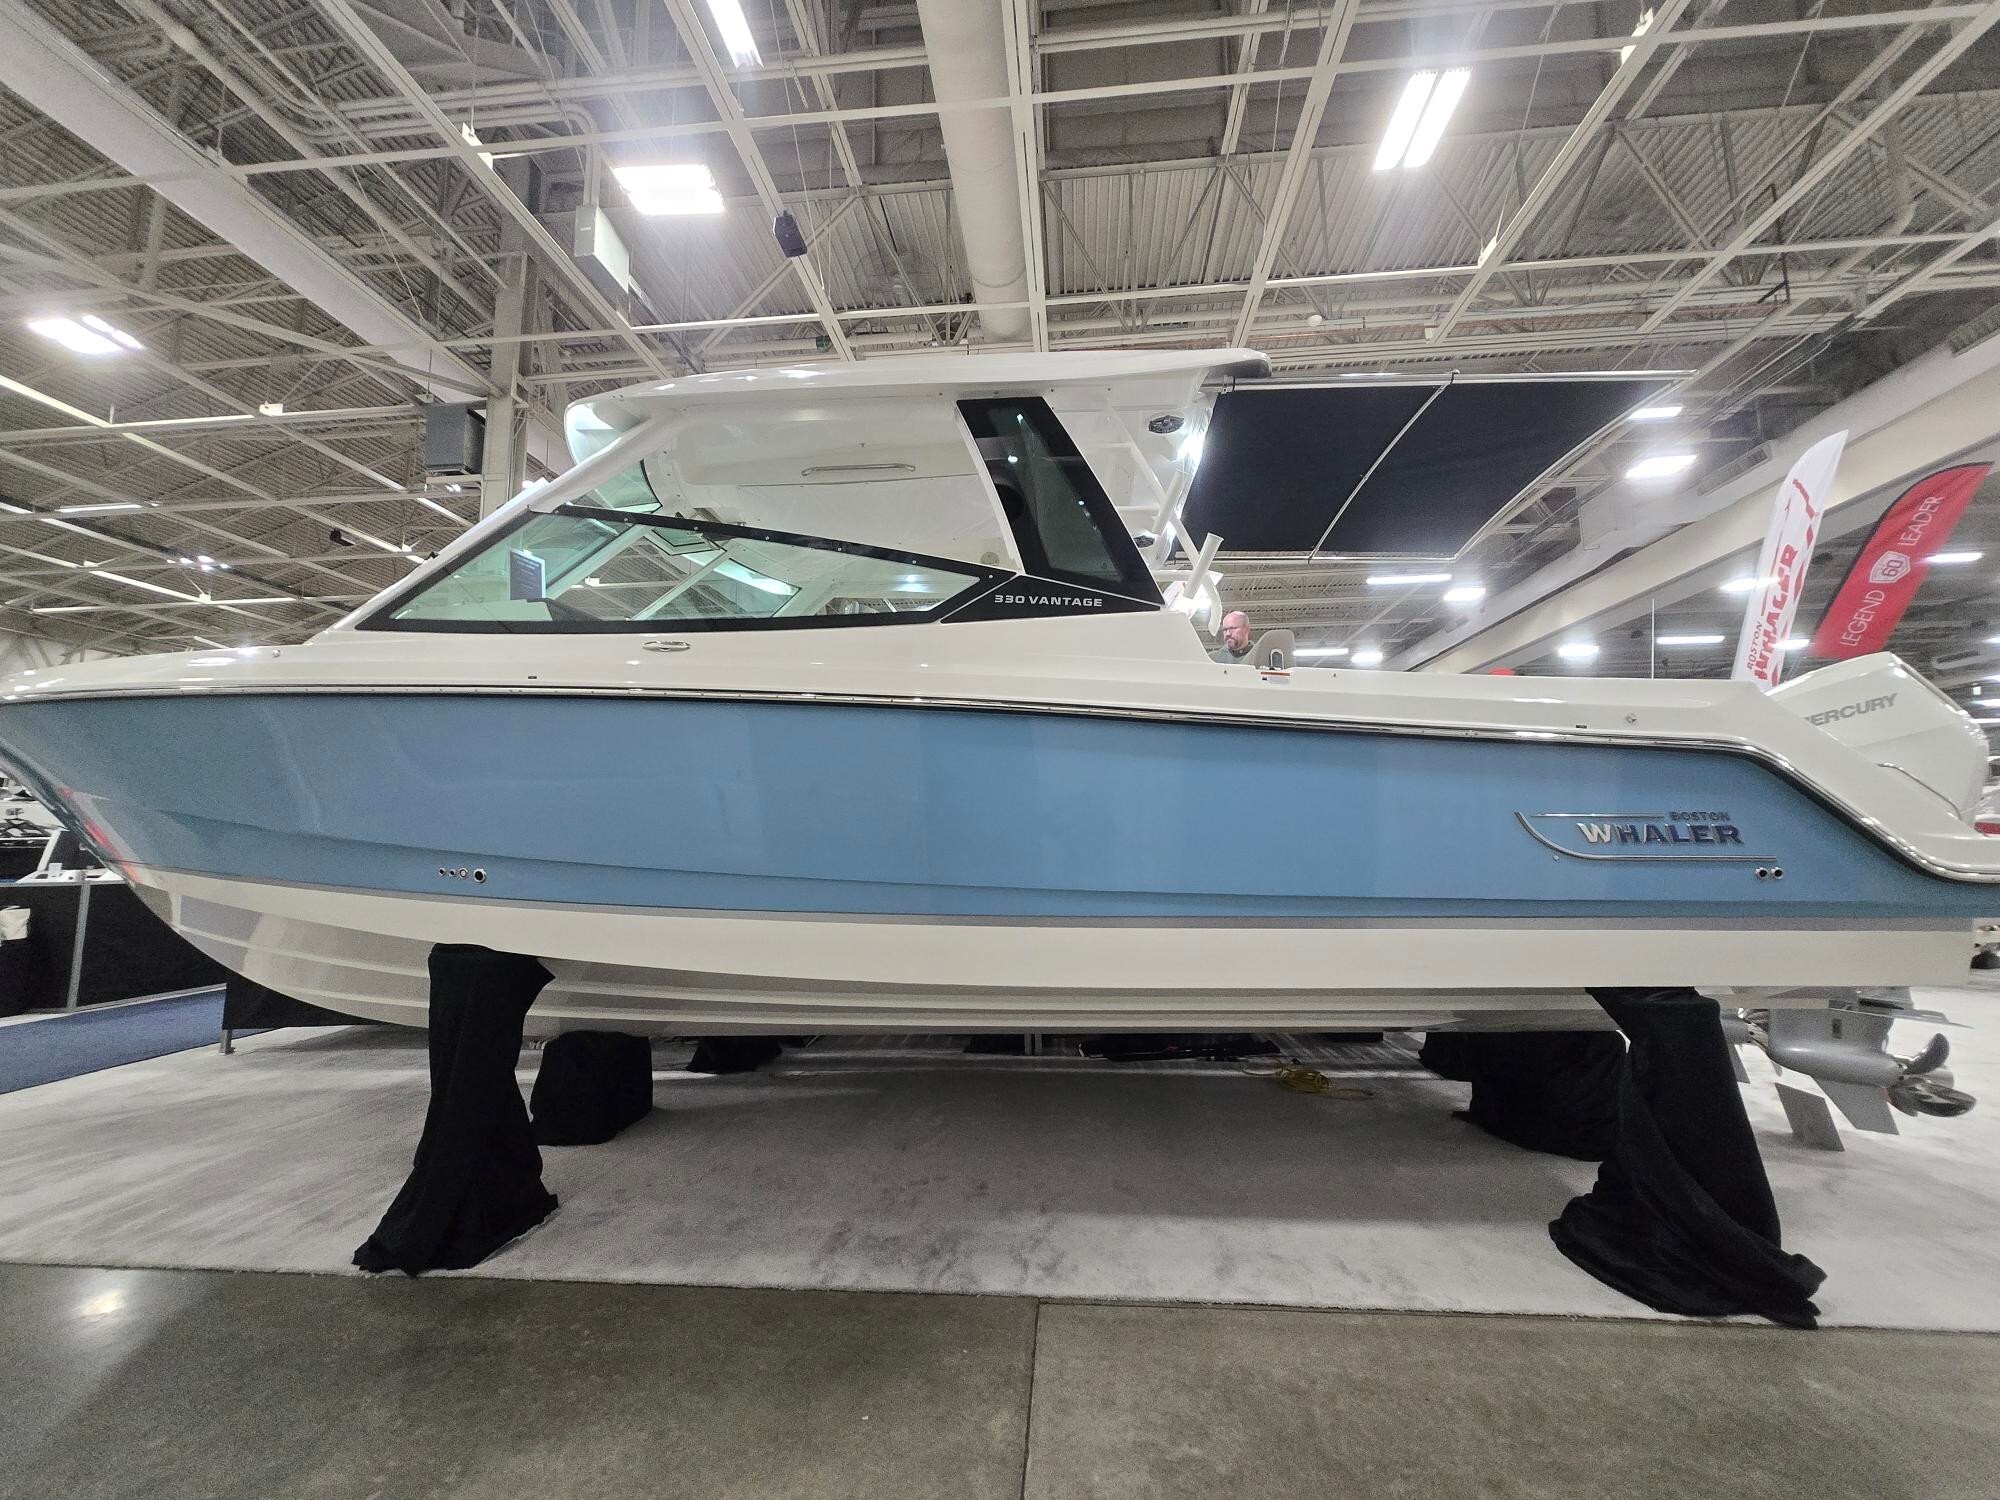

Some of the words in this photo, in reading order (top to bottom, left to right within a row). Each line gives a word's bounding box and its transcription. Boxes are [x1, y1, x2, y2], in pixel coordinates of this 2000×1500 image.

[1839, 590, 1885, 646] LEGEND
[1882, 559, 1904, 577] 60
[1897, 496, 1945, 546] LEADER
[994, 594, 1025, 604] 330
[1029, 595, 1103, 607] VANTAGE
[1747, 621, 1763, 670] BOSTON
[1804, 692, 1897, 726] ERCURY
[1669, 811, 1731, 821] BOSTON
[1576, 822, 1744, 844] WHALER
